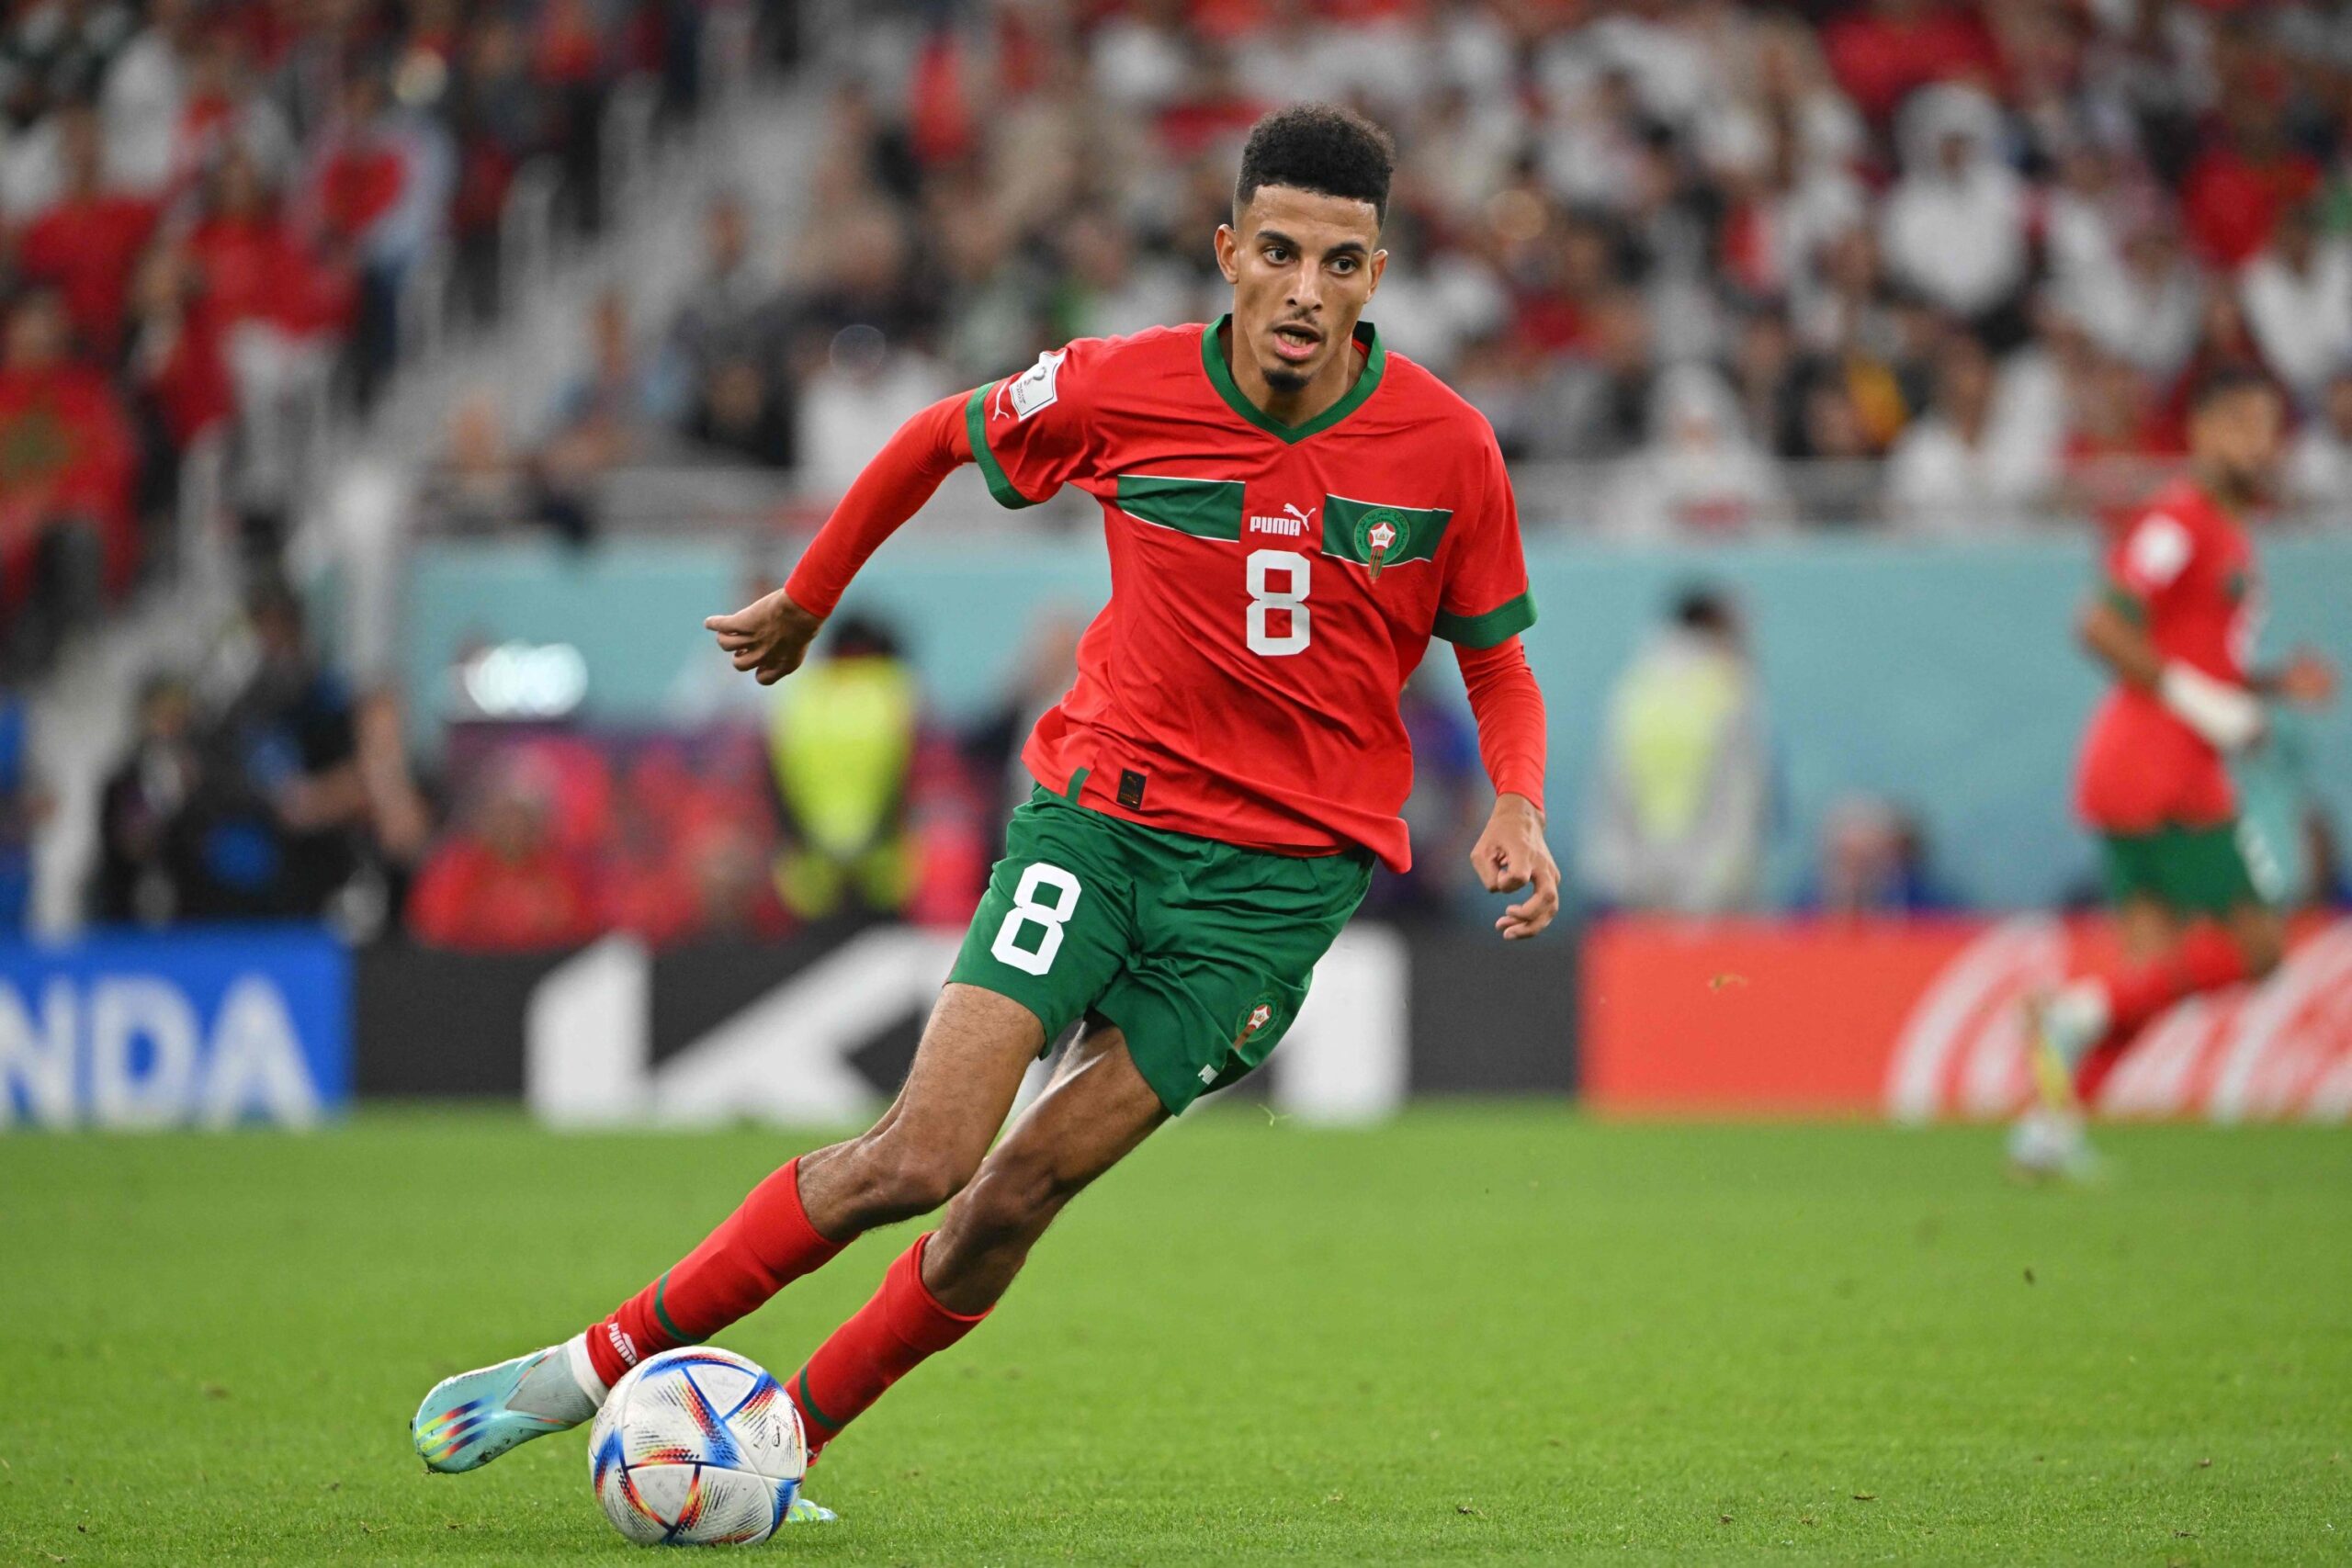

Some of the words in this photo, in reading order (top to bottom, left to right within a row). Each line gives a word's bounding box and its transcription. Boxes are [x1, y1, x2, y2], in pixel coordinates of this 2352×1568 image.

[1250, 516, 1301, 536] PUMA
[1246, 548, 1310, 656] 8
[990, 863, 1081, 976] 8
[607, 1323, 637, 1366] PUMA
